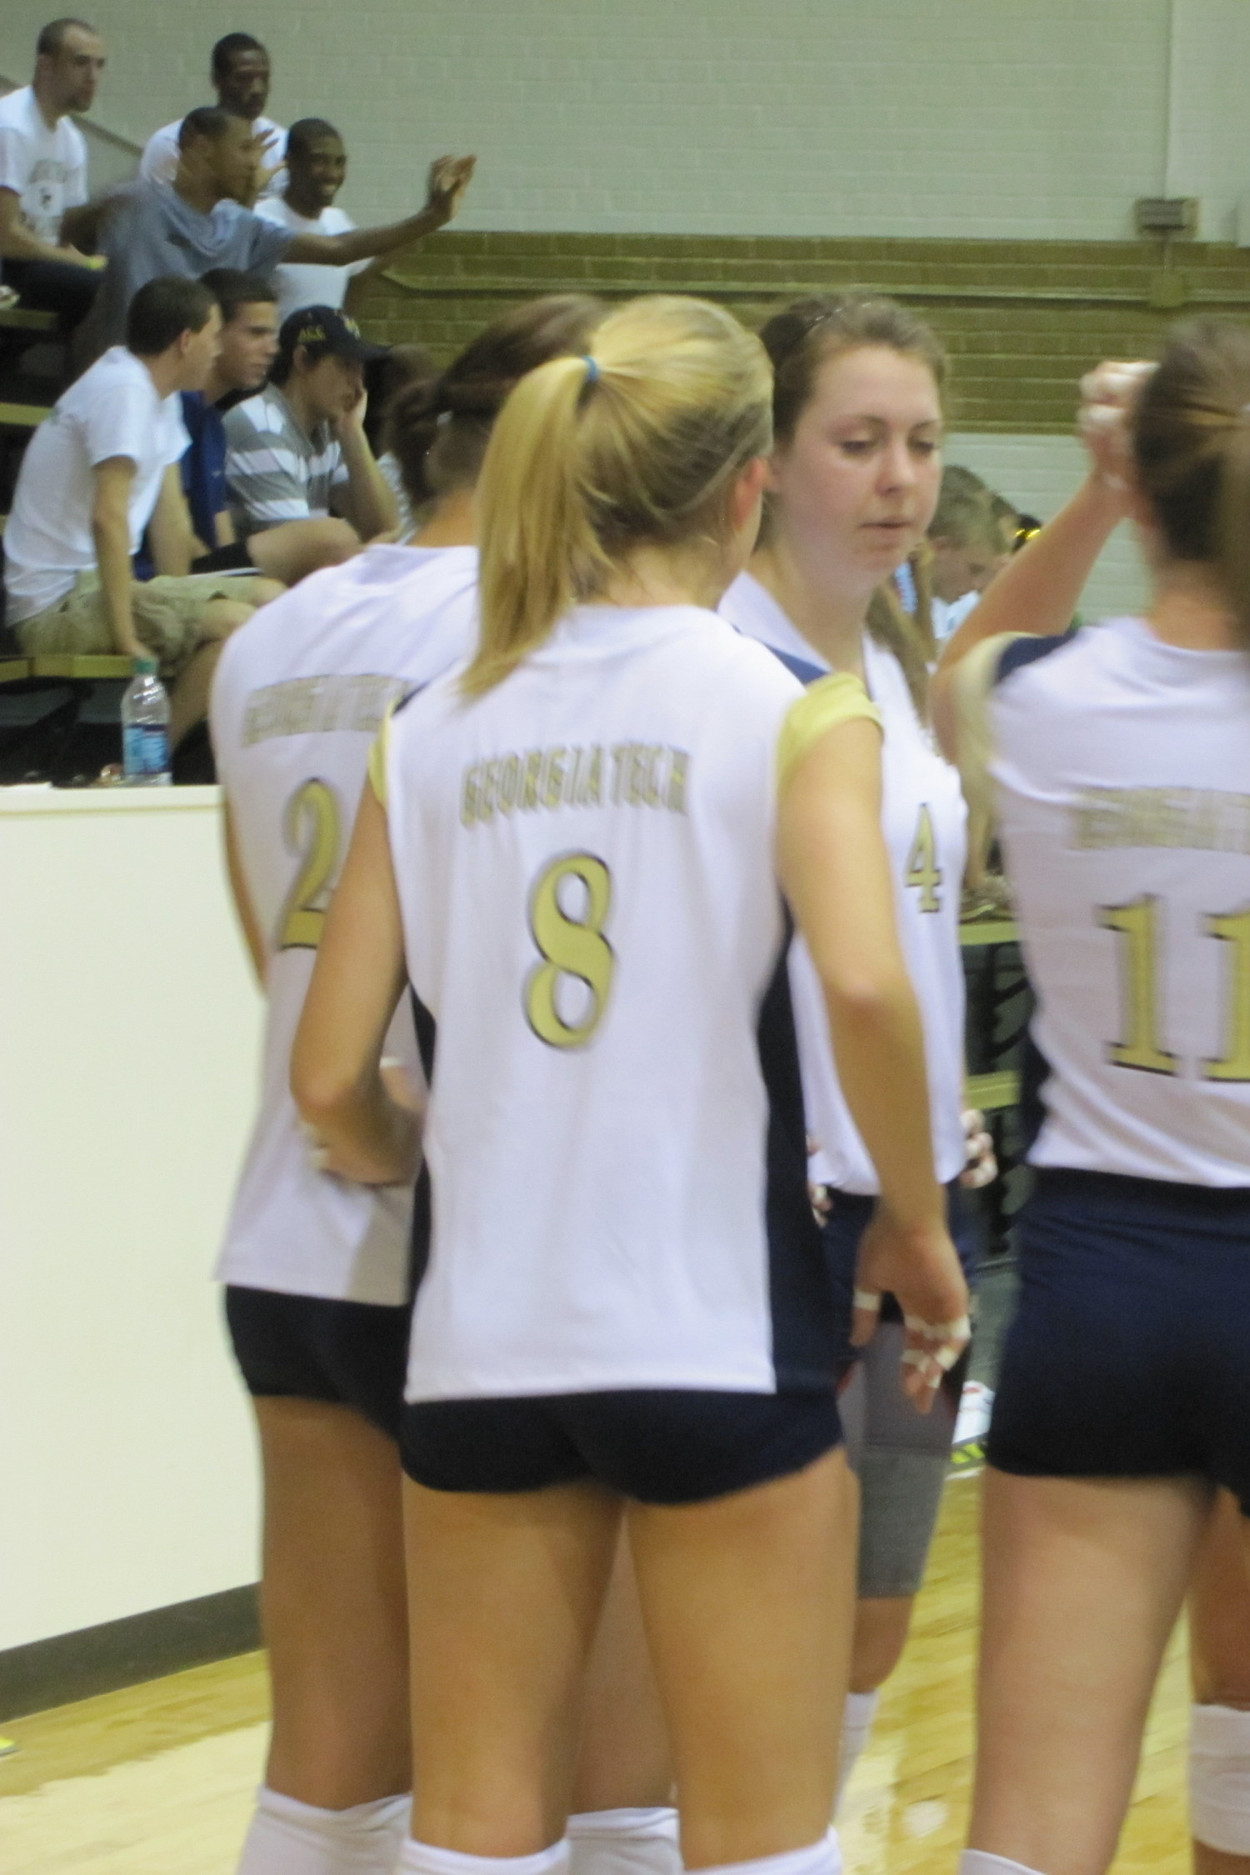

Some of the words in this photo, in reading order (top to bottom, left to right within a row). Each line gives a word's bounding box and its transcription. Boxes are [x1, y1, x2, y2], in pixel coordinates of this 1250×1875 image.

[276, 775, 342, 952] 2
[904, 802, 942, 913] 4
[523, 850, 615, 1052] 8
